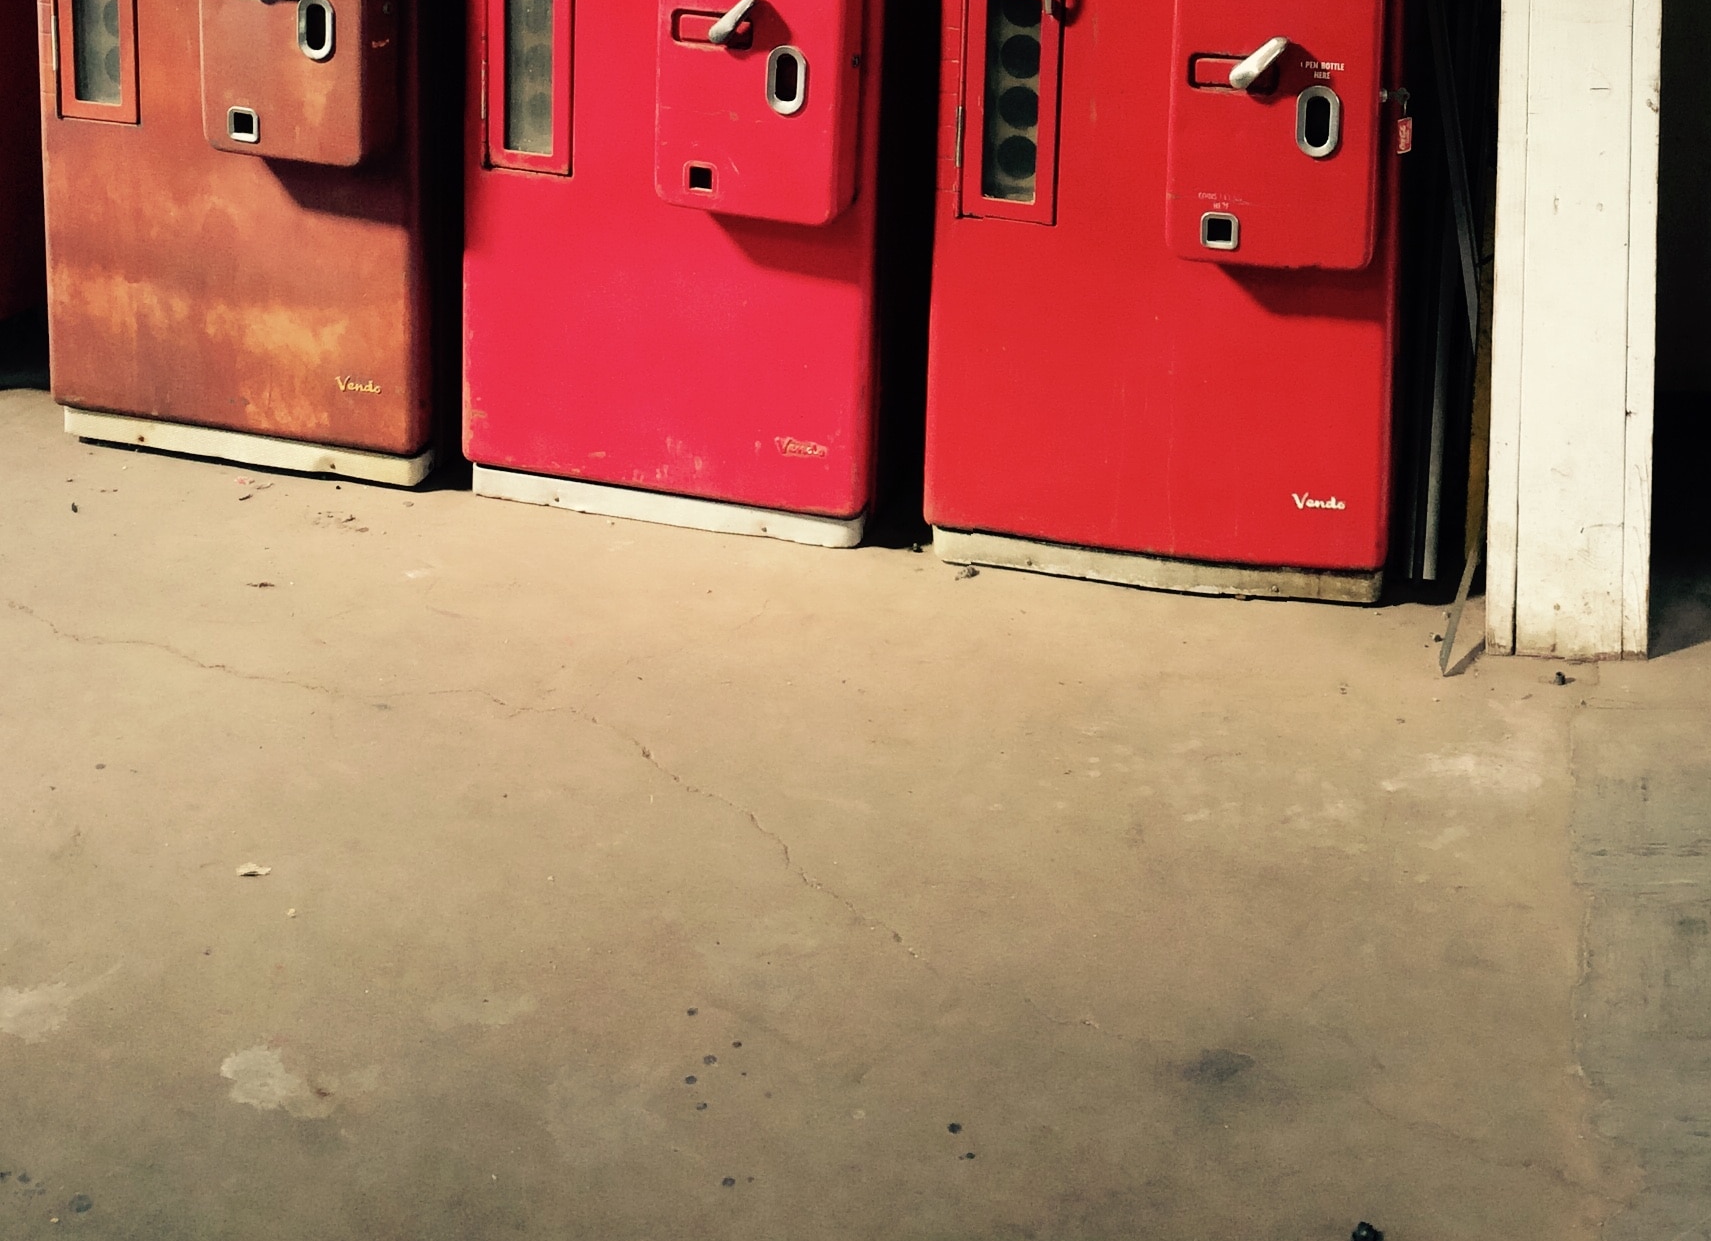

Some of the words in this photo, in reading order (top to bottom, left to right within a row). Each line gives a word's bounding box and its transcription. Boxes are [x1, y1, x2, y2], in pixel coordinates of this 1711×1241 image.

[1321, 62, 1345, 71] BOTTLE
[1314, 71, 1330, 79] HERE
[335, 375, 382, 394] Vendo
[1291, 492, 1346, 510] Vendo
